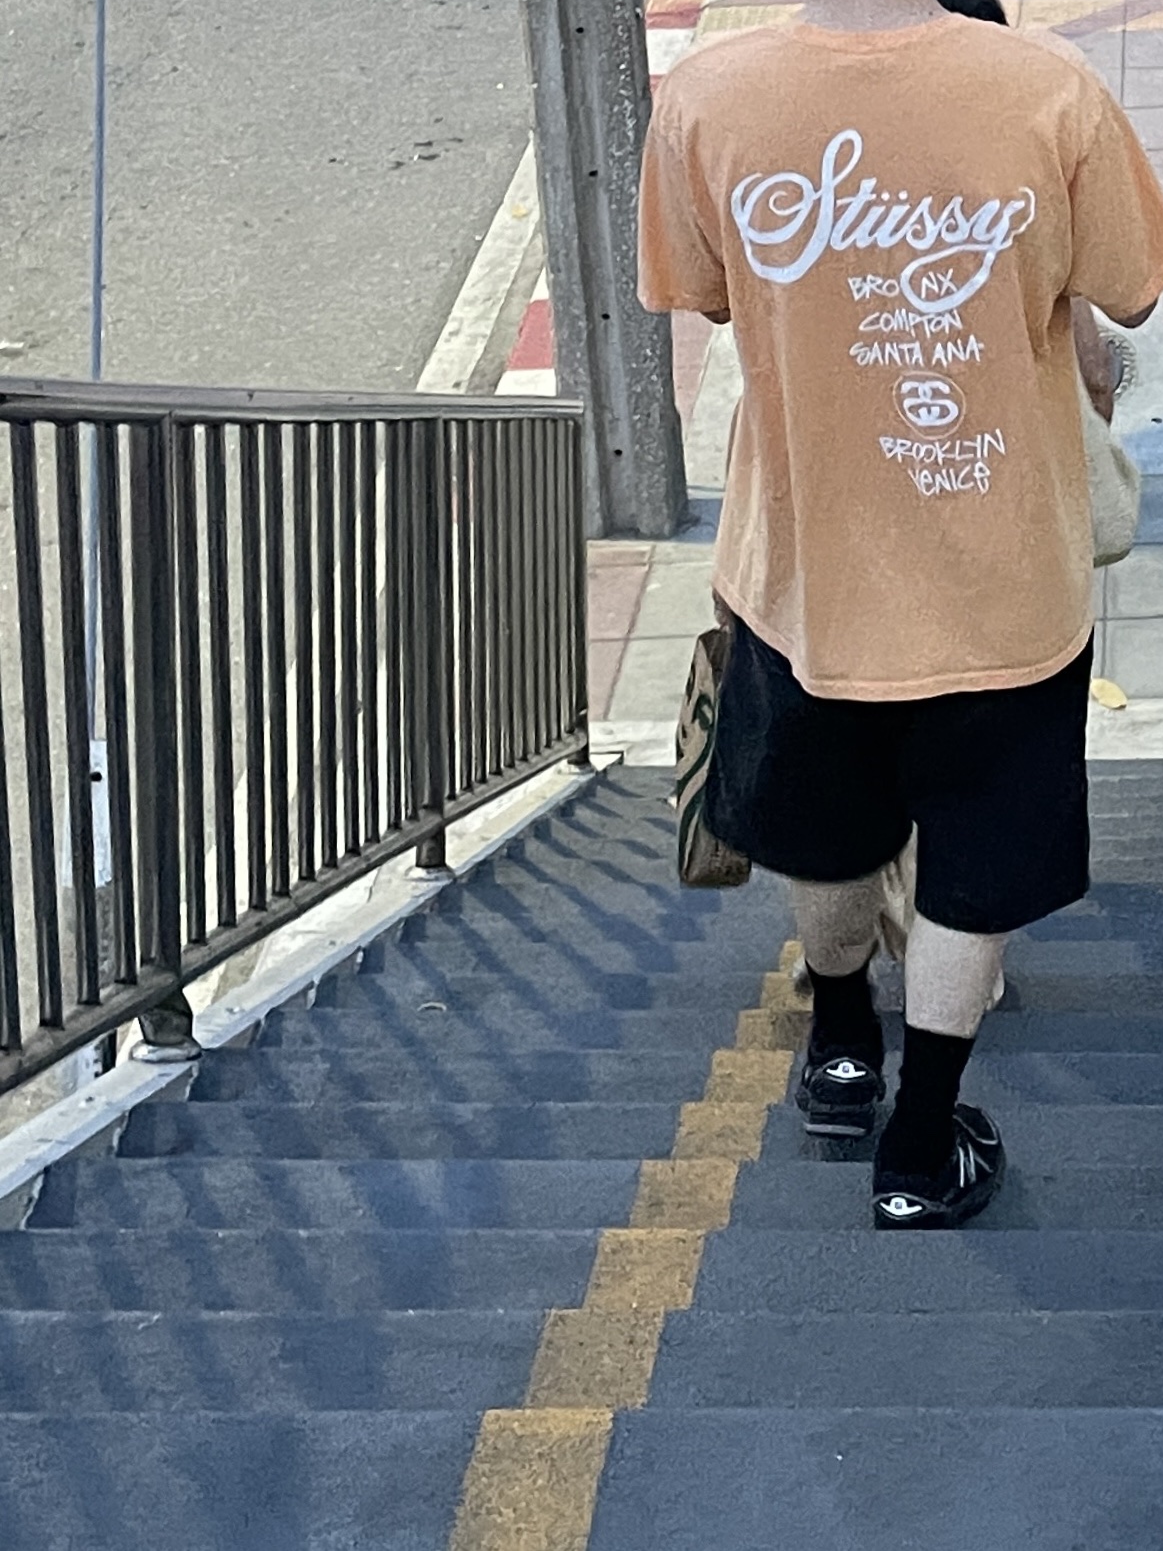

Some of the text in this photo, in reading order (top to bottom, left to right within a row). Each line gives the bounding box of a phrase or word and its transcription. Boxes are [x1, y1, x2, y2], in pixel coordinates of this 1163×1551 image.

[730, 128, 1036, 313] Stüssy
[858, 308, 963, 338] COMPTON
[849, 339, 925, 367] SANTA
[878, 428, 1007, 465] BROOKLYN
